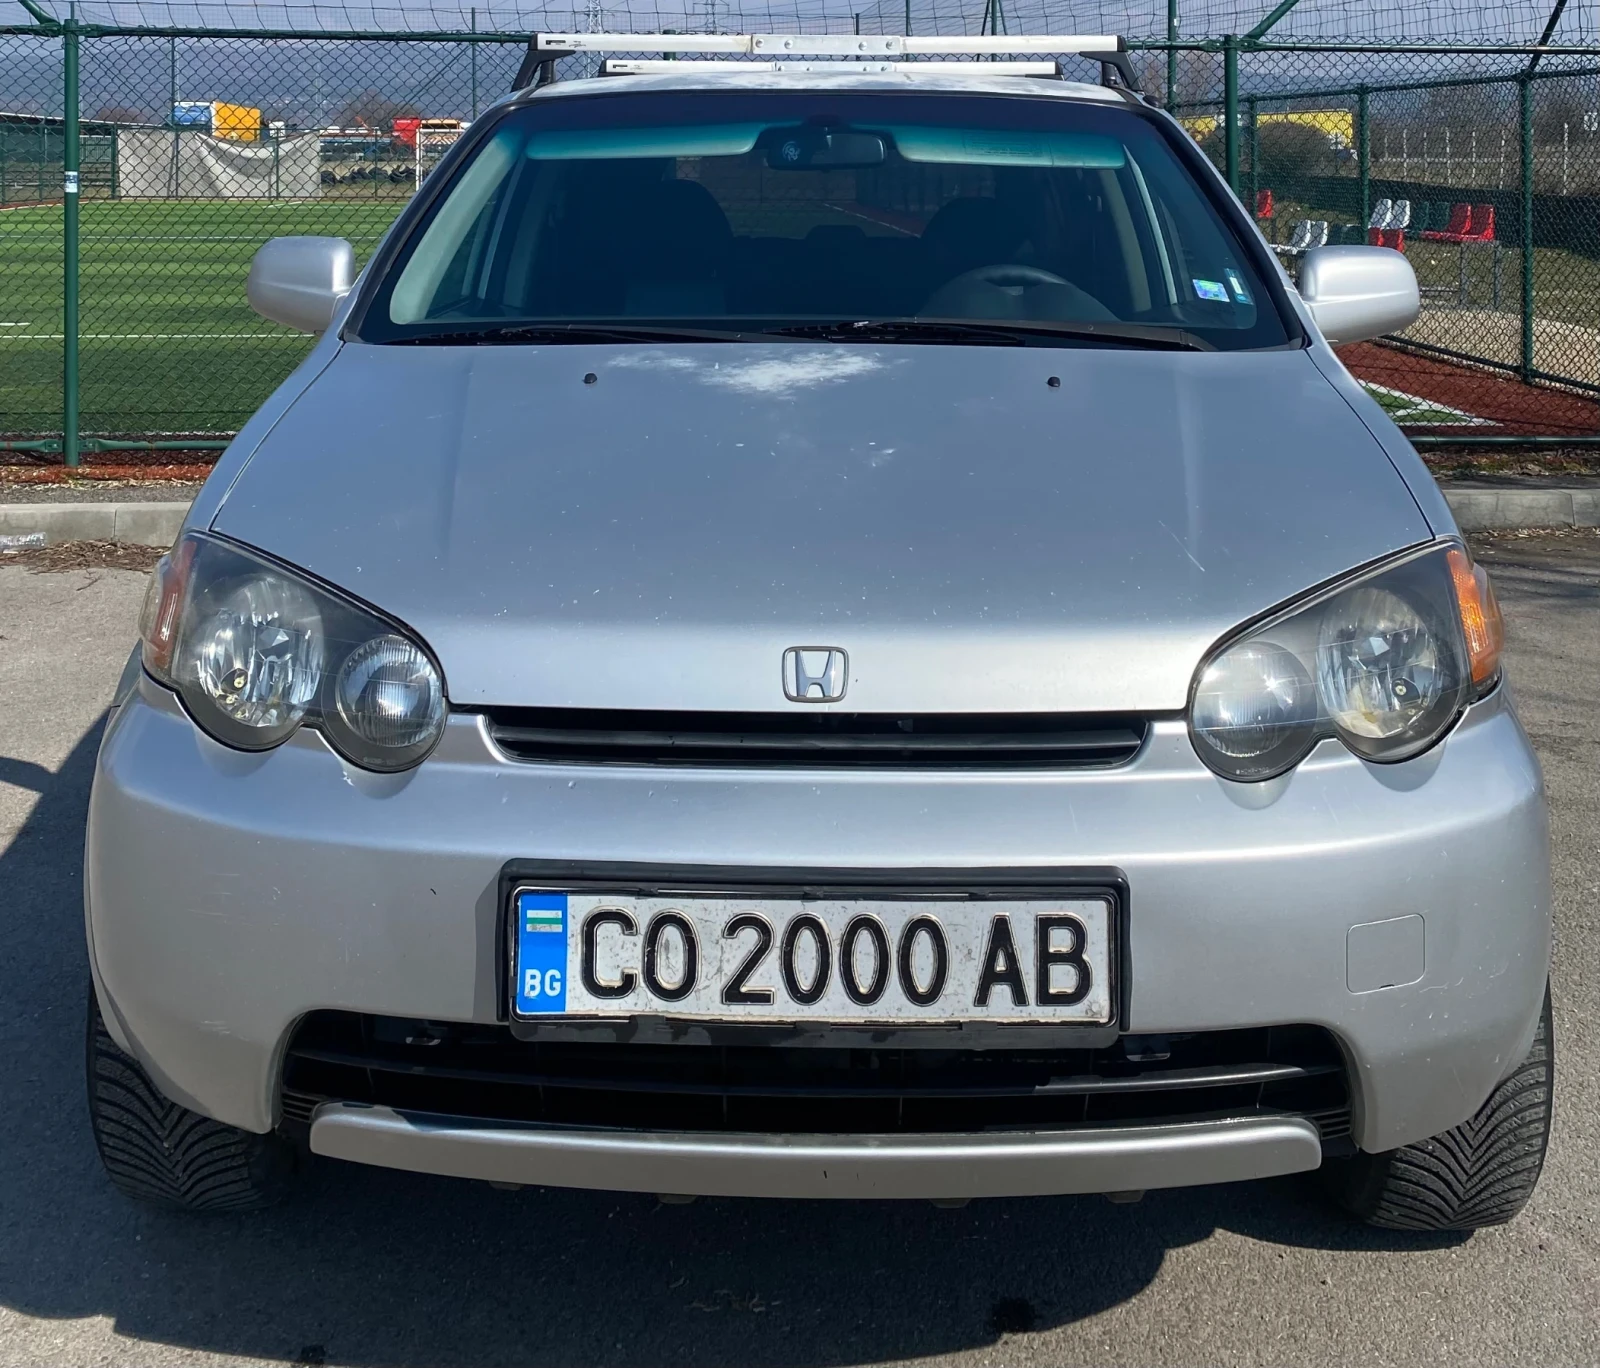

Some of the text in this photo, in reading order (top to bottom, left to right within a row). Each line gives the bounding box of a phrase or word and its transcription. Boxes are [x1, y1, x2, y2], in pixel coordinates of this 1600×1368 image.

[524, 969, 561, 997] BG
[721, 912, 951, 1006] 2000
[973, 912, 1094, 1008] AB
